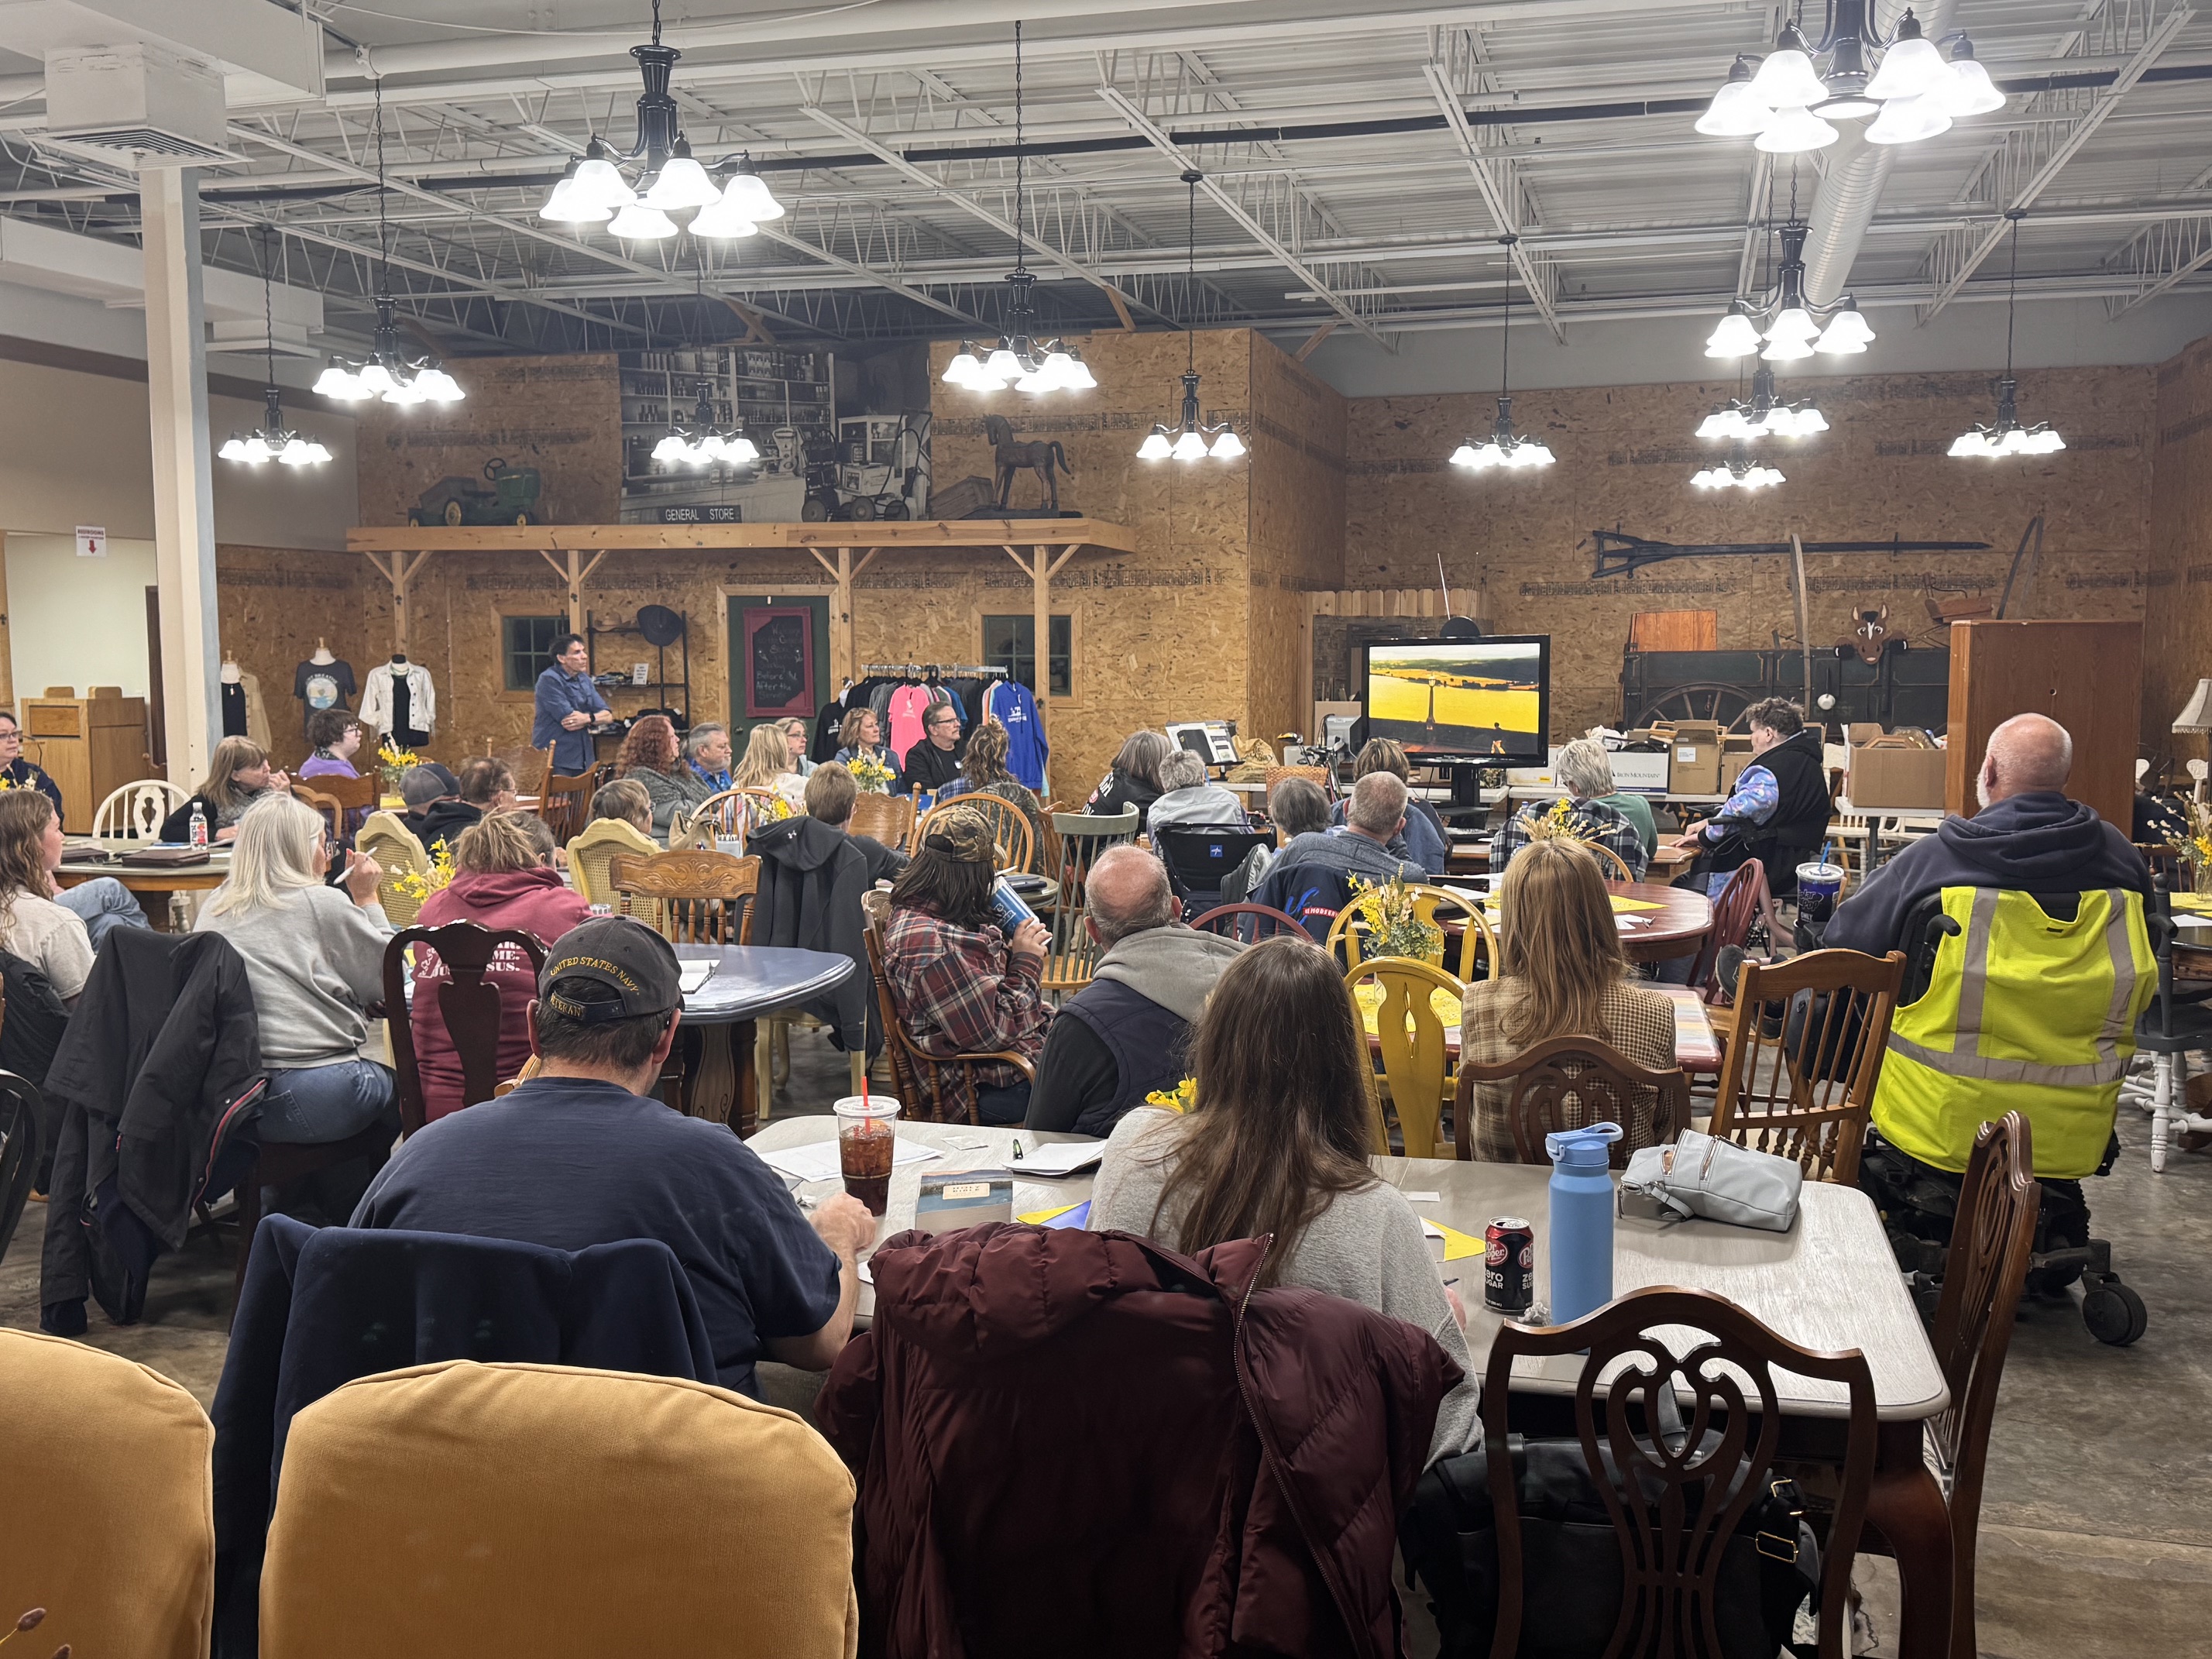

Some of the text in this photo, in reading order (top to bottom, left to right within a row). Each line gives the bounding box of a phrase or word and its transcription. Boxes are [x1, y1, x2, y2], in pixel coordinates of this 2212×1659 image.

[665, 508, 734, 520] GENERAL STORE
[550, 957, 579, 976] UNITED
[579, 956, 618, 974] STATES
[1486, 1269, 1504, 1283] ero
